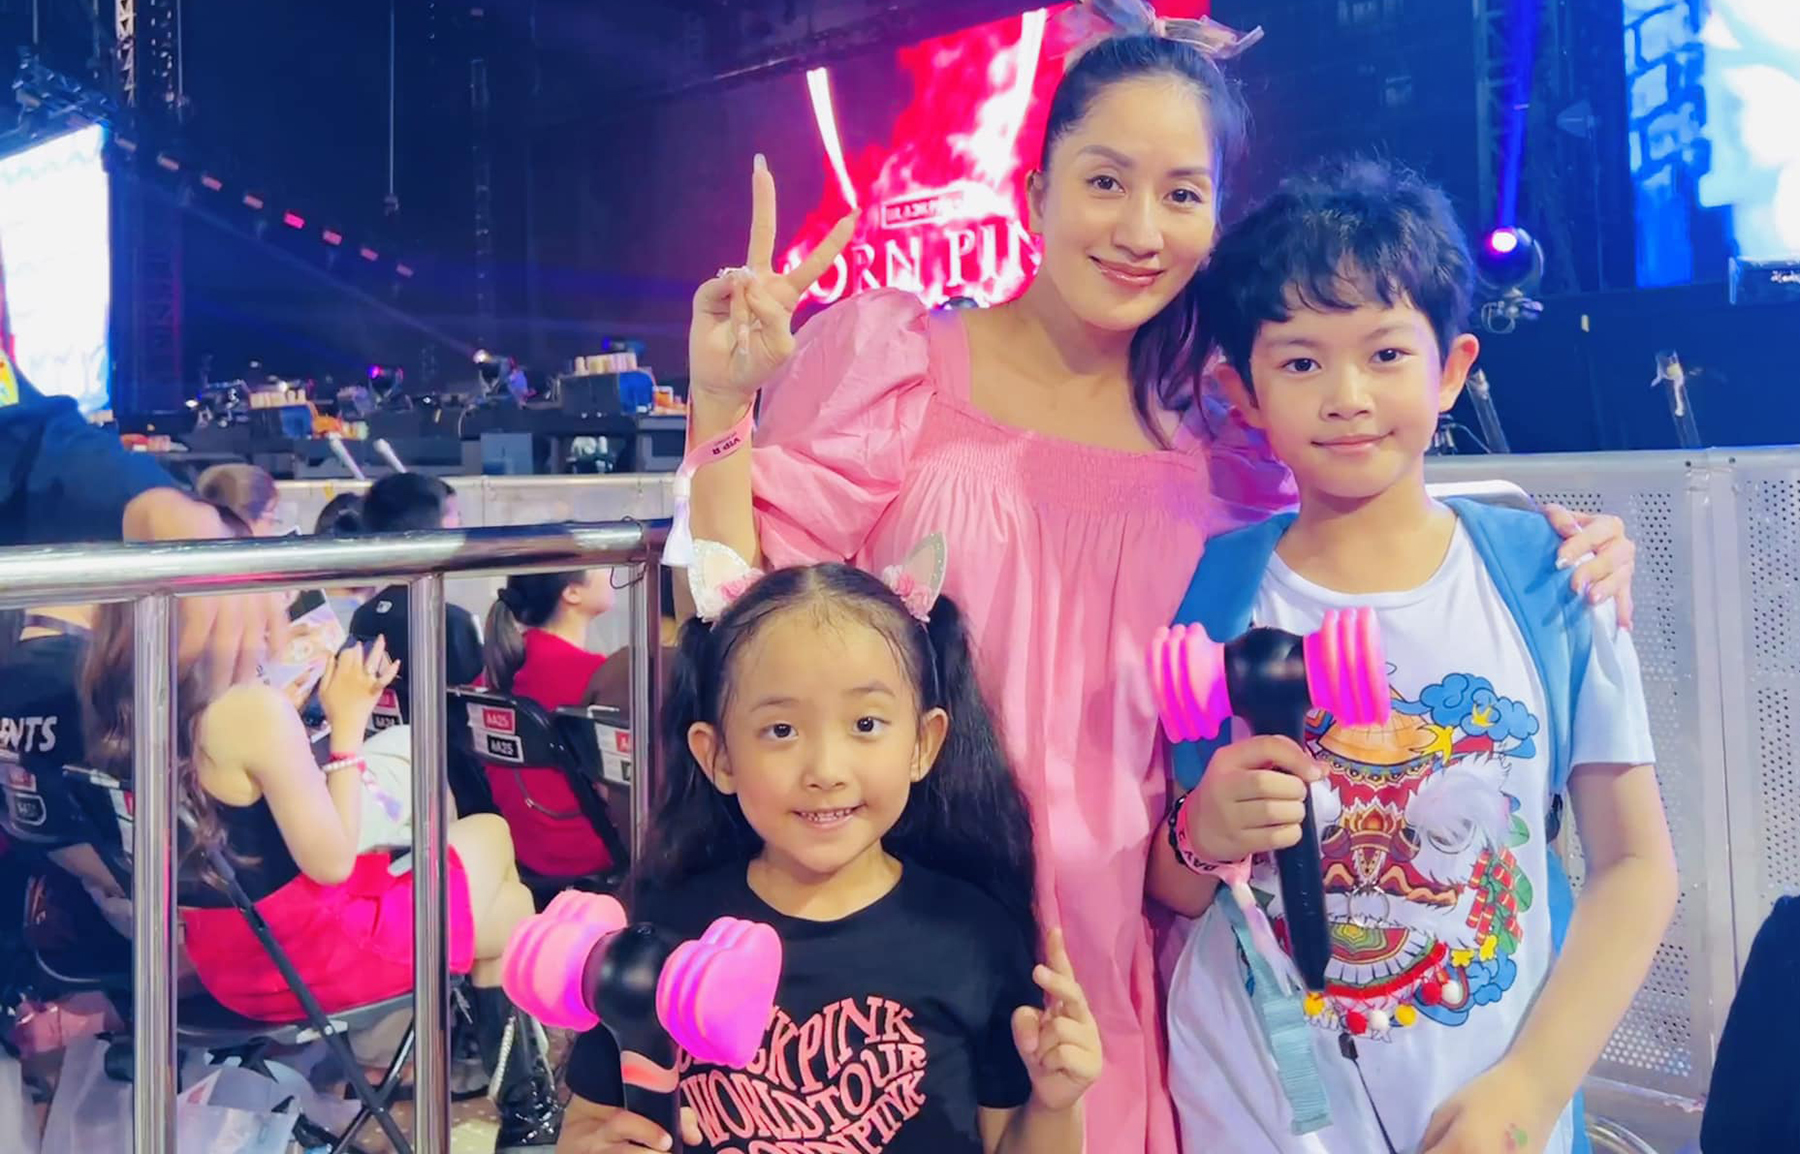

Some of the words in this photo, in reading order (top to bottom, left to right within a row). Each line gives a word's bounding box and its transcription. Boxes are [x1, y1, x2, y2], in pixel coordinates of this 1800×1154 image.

[783, 236, 924, 304] ORN
[722, 437, 741, 450] VIP
[0, 716, 58, 752] NTS
[680, 996, 924, 1093] KPINK
[680, 1070, 824, 1147] WORLD
[806, 1043, 927, 1133] TOUR
